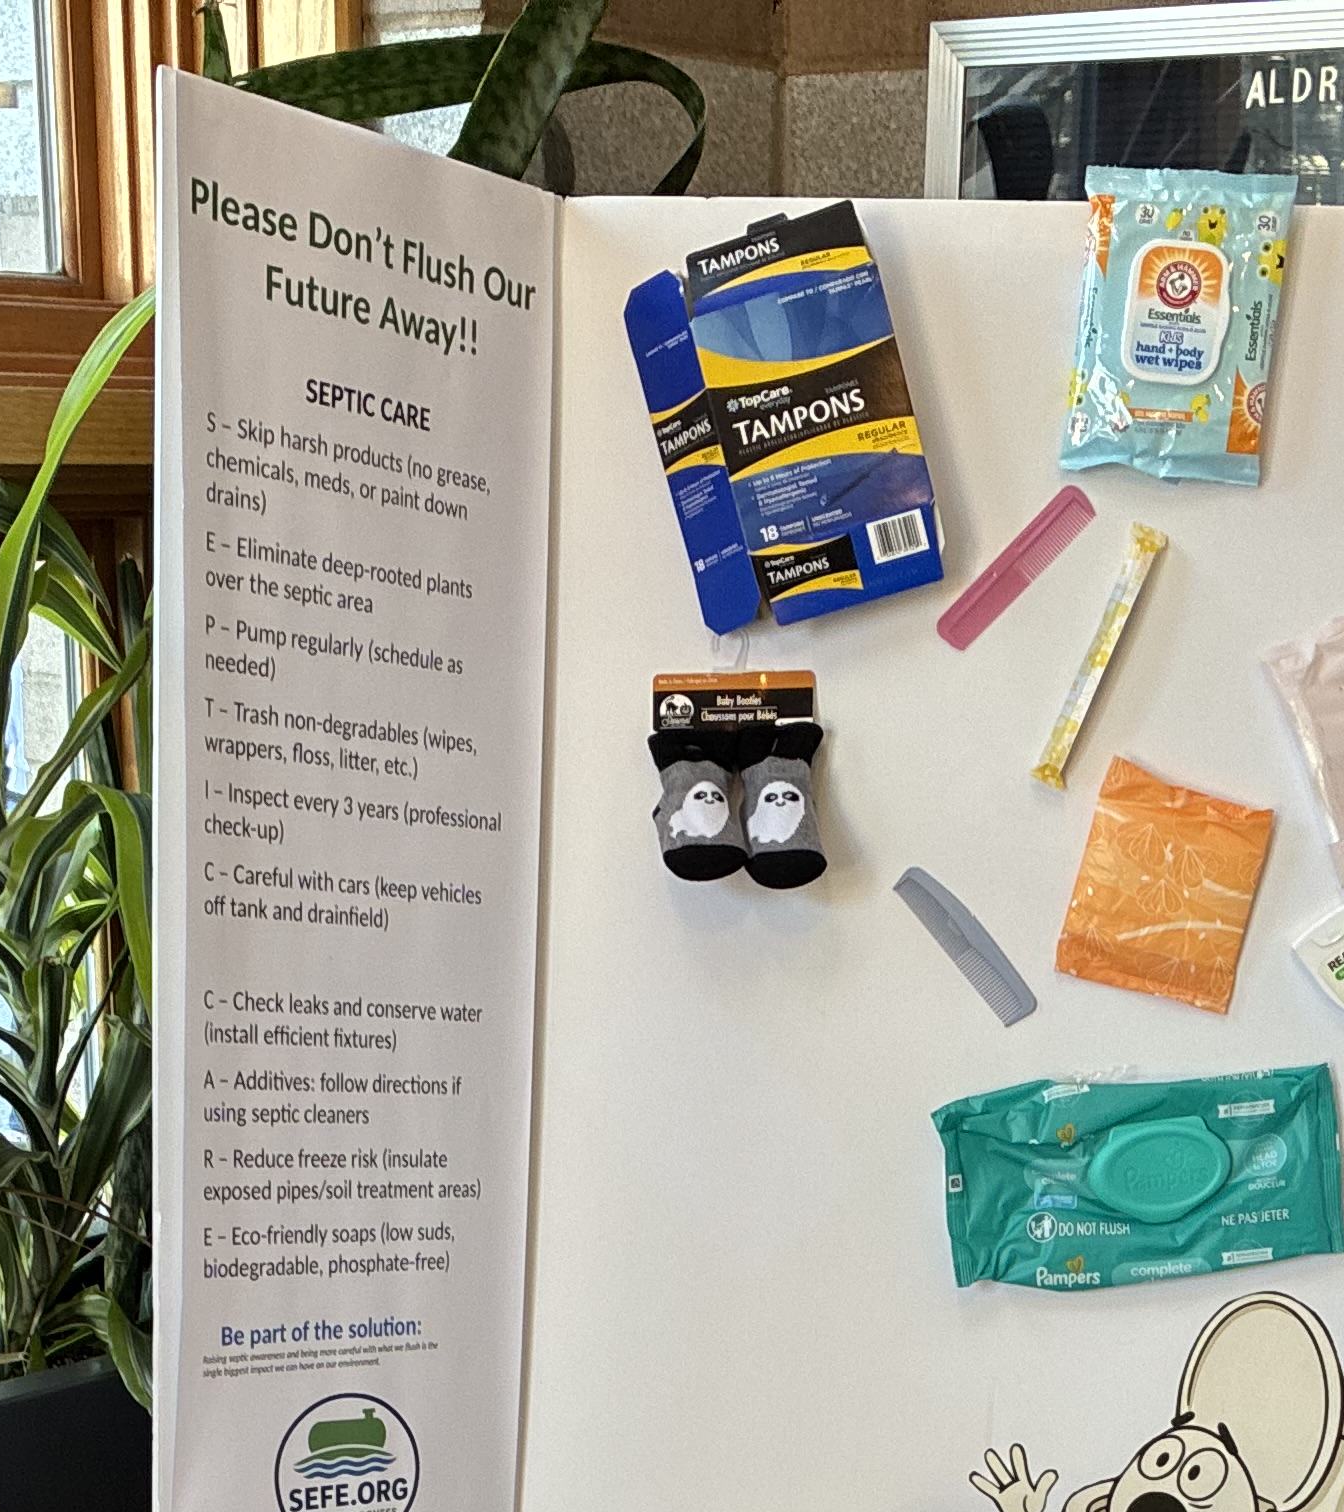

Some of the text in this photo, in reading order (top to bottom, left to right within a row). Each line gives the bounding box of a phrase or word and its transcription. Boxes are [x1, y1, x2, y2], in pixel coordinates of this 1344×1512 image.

[1258, 215, 1271, 232] 30
[190, 175, 298, 242] Please
[402, 237, 475, 295] Flush
[482, 265, 537, 311] Our
[697, 237, 780, 275] TAMPONS
[265, 262, 477, 357] Future Away!!
[1148, 308, 1202, 325] Essentials
[1245, 300, 1263, 362] Essentials
[1135, 353, 1202, 372] wet wipes
[1136, 341, 1166, 354] hand
[1176, 343, 1204, 361] body
[304, 377, 431, 433] SEPTIC CARE
[738, 385, 791, 409] TopCare
[732, 389, 865, 445] TAMPONS
[857, 420, 906, 441] REGULAR
[660, 417, 712, 456] TAMPONS
[205, 410, 491, 497] S Skip harsh products (no grease,
[205, 445, 468, 521] chemicals, meds, or paint down
[205, 479, 267, 517] drains)
[759, 524, 780, 543] 18
[767, 556, 830, 585] TAMPONS
[1058, 1222, 1131, 1237] DO NOT FLUSH
[1221, 1208, 1290, 1226] NE PAS JETER
[1036, 1266, 1101, 1288] Pampers
[1130, 1262, 1193, 1277] complete
[220, 1314, 422, 1350] Be part of the solution:
[289, 1478, 409, 1512] SEFE.ORG
